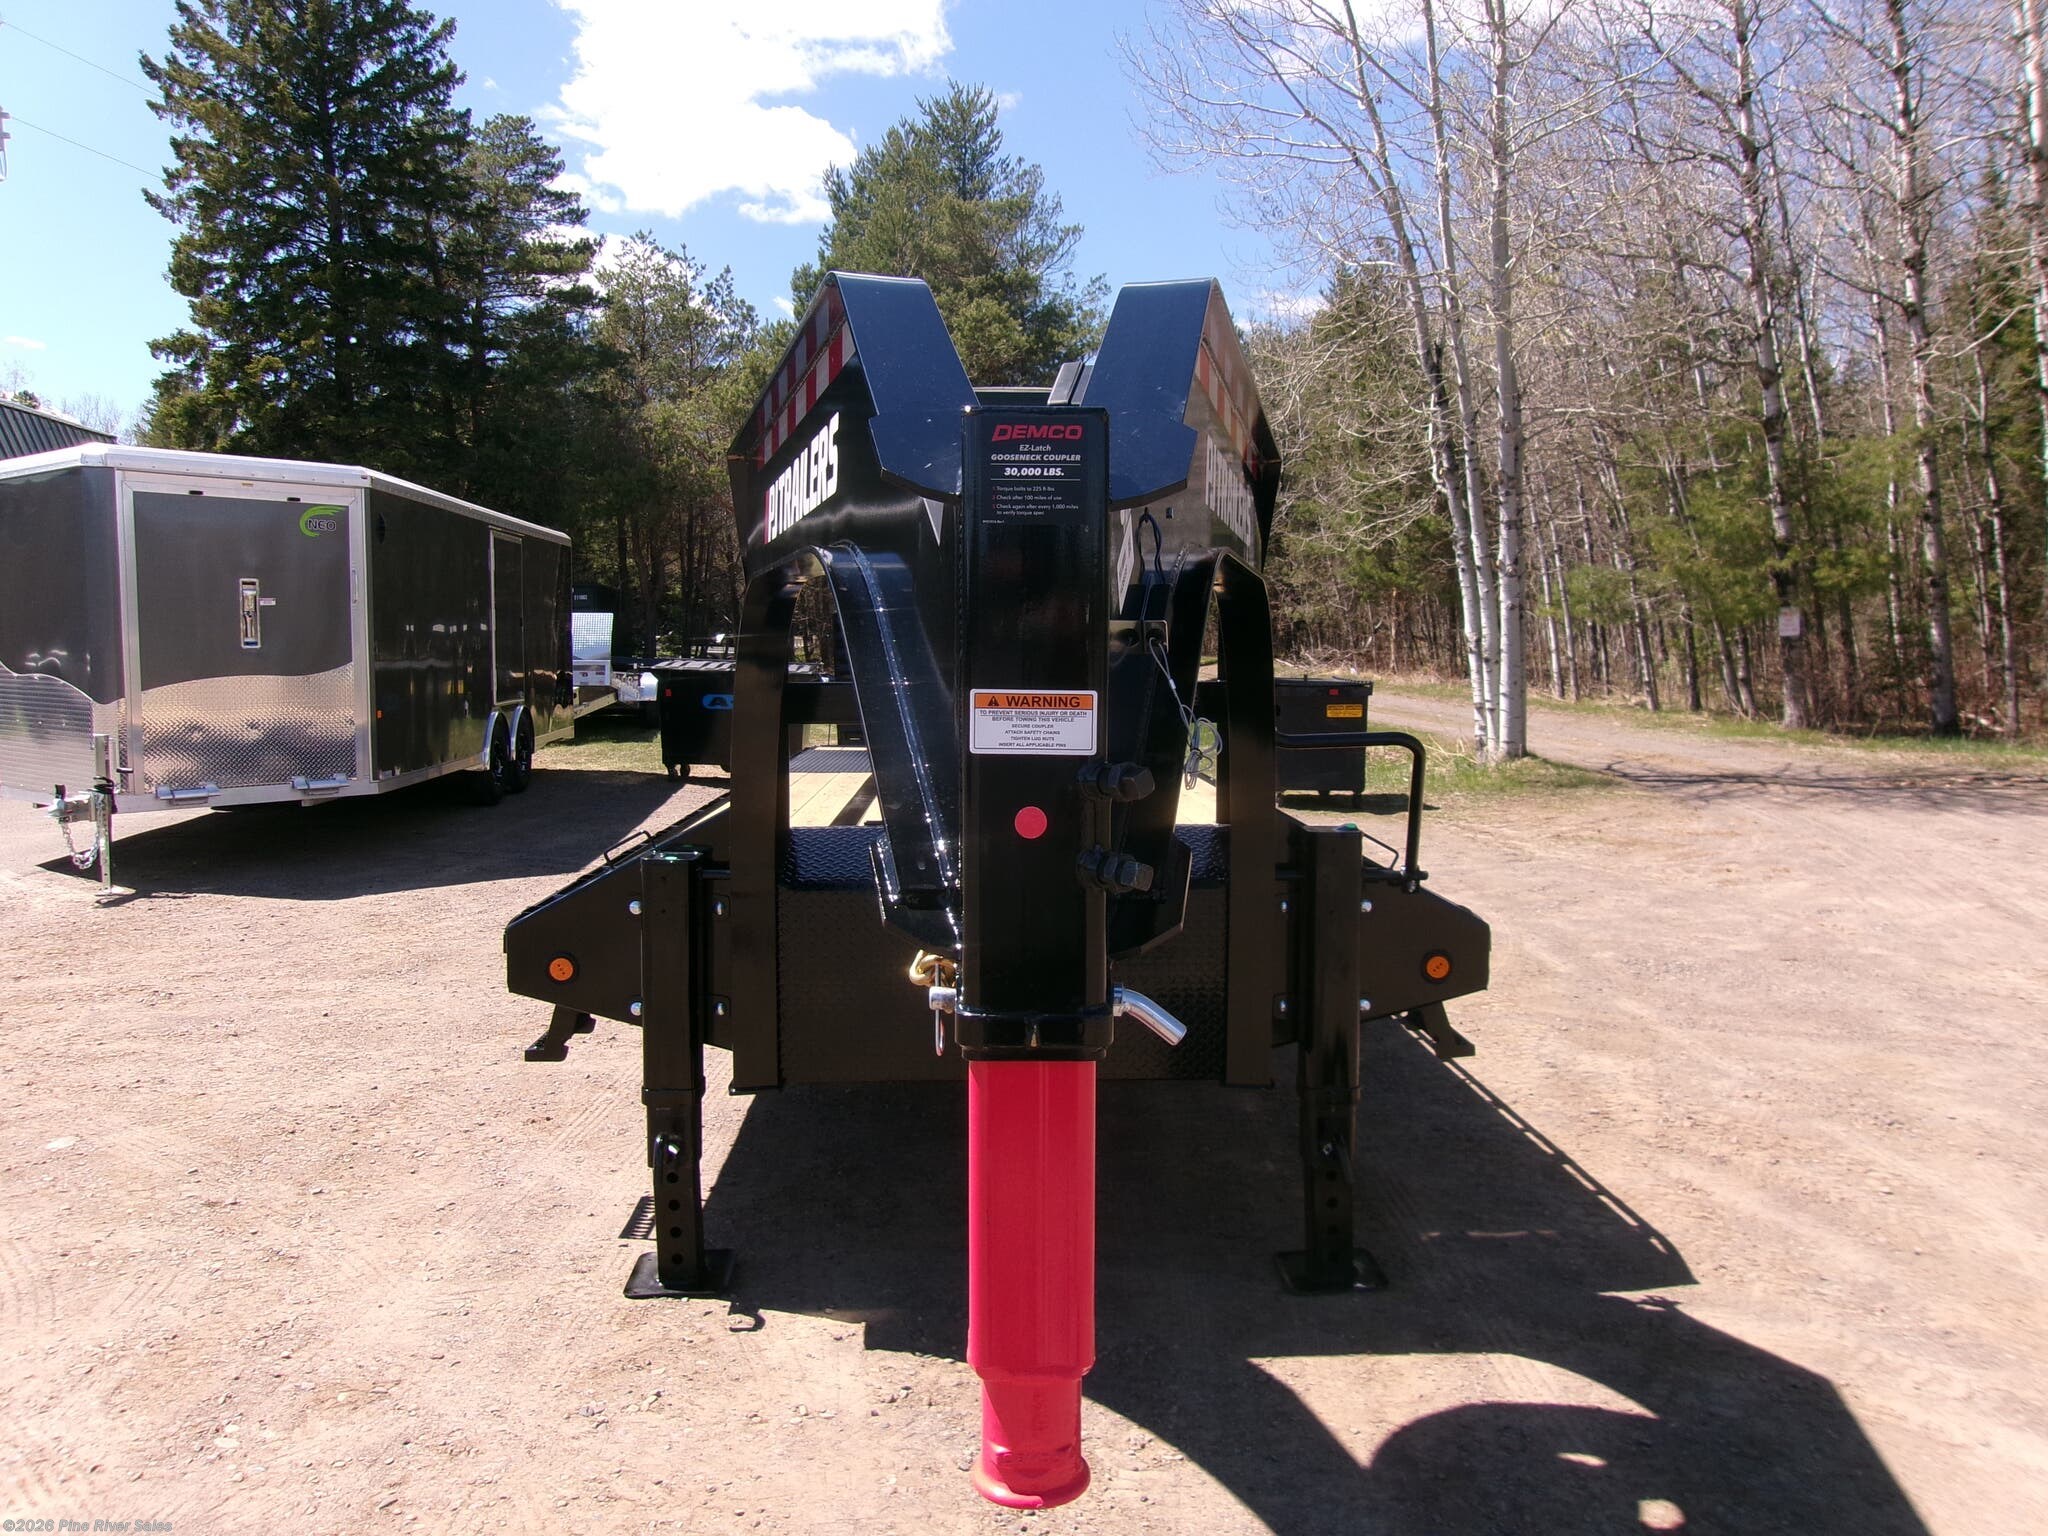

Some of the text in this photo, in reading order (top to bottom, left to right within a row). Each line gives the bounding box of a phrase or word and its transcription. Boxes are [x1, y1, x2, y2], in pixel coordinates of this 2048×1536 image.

[991, 424, 1083, 442] DEMCO
[1004, 468, 1064, 476] 30,000 LBS.
[308, 518, 336, 531] NEO
[1006, 696, 1080, 708] WARNING
